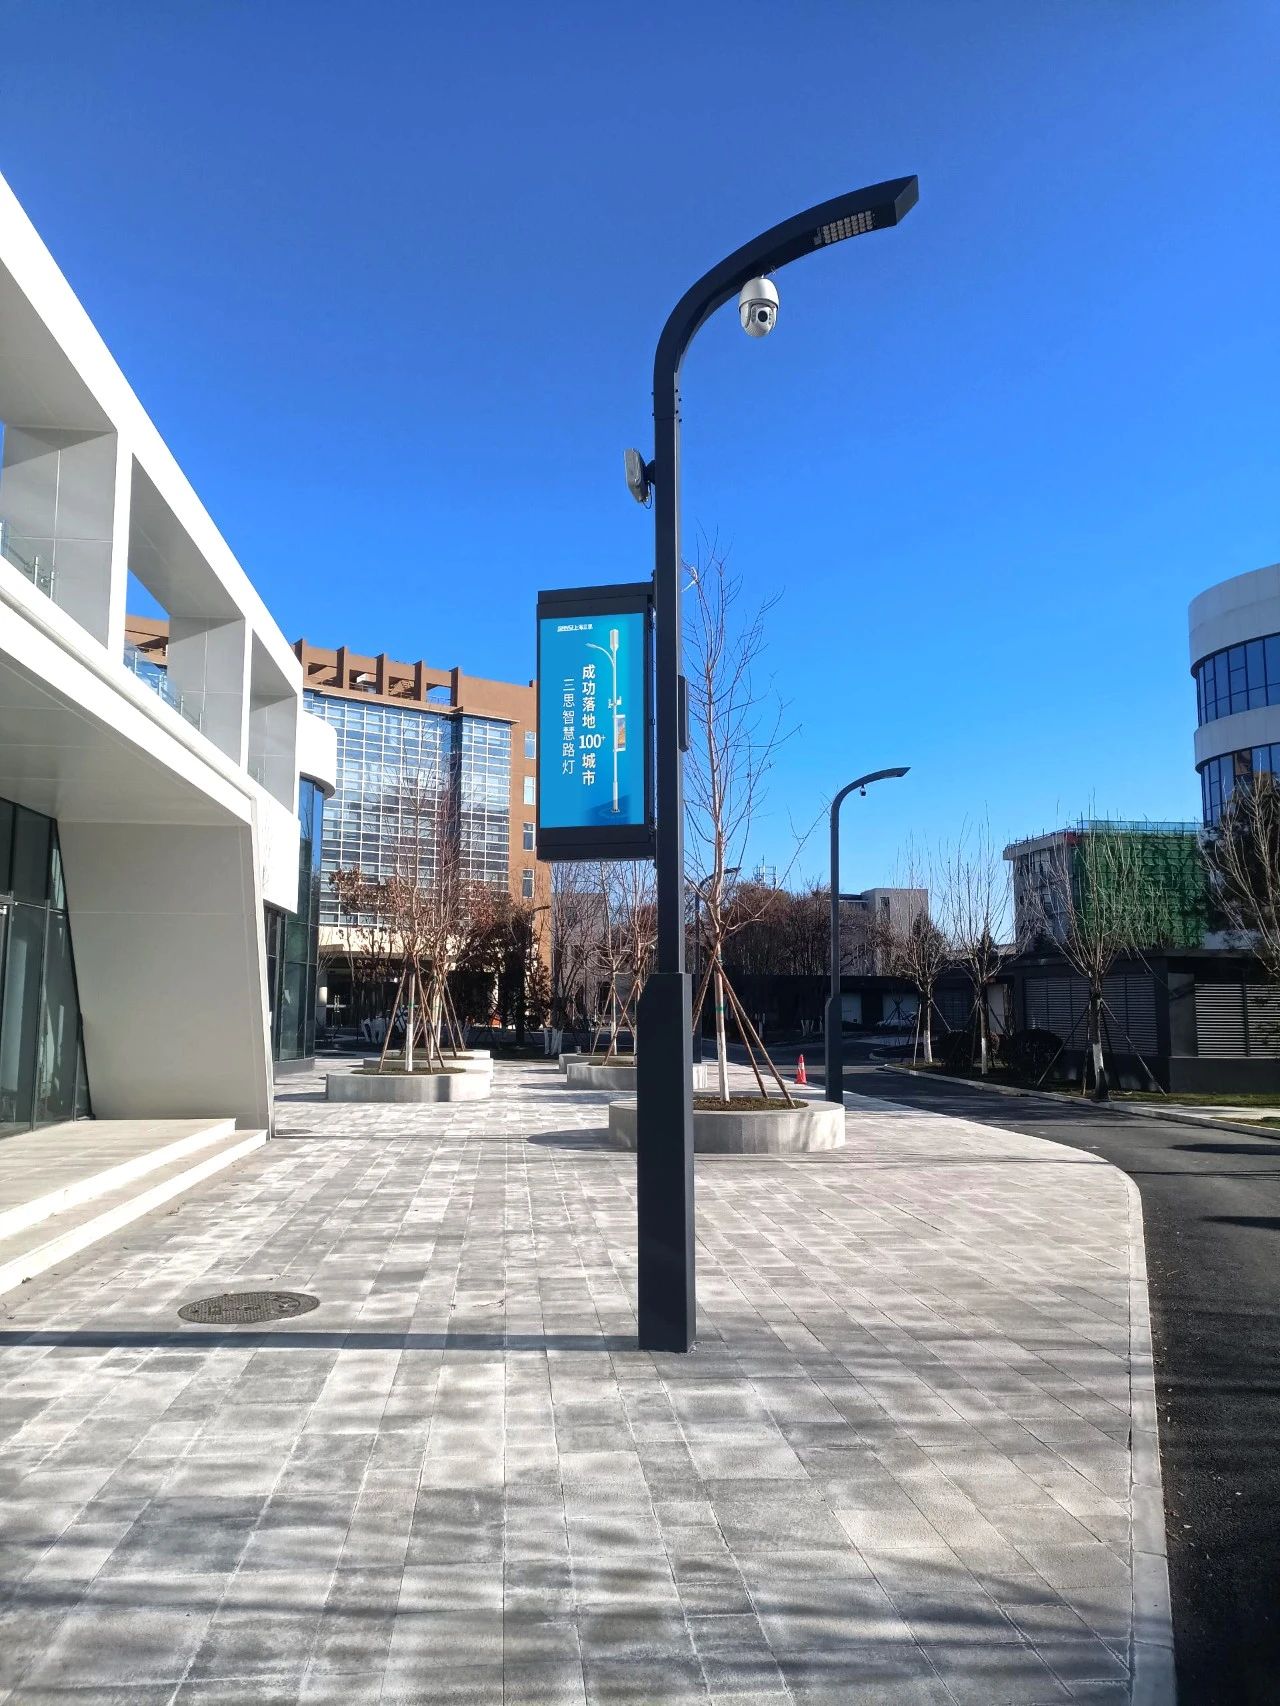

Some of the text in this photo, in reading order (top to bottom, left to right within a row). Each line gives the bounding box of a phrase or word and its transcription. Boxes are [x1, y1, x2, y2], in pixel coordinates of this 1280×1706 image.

[562, 678, 576, 775] 三思智慧路灯
